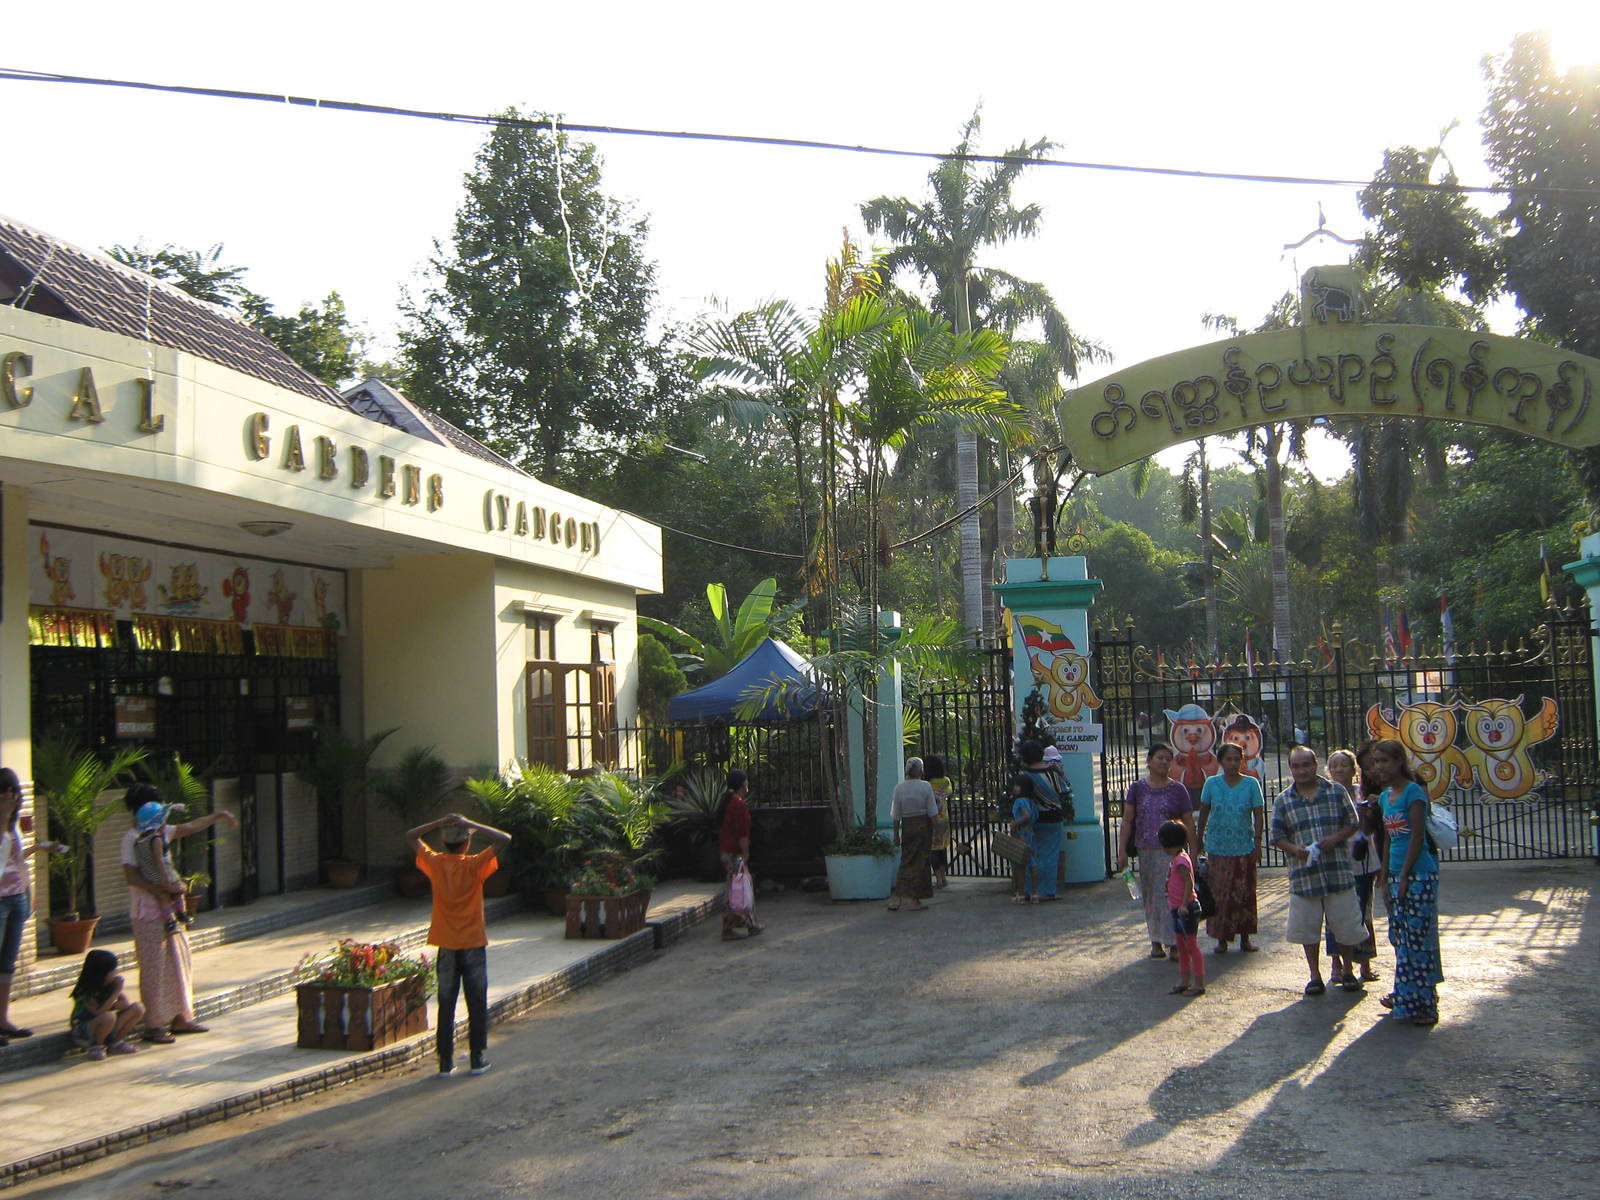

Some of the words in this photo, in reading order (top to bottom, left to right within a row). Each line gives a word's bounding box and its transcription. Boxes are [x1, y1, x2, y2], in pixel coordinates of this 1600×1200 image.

[243, 411, 443, 513] GARDENS
[482, 488, 601, 558] (YANGON)
[1067, 735, 1098, 743] GARDEN
